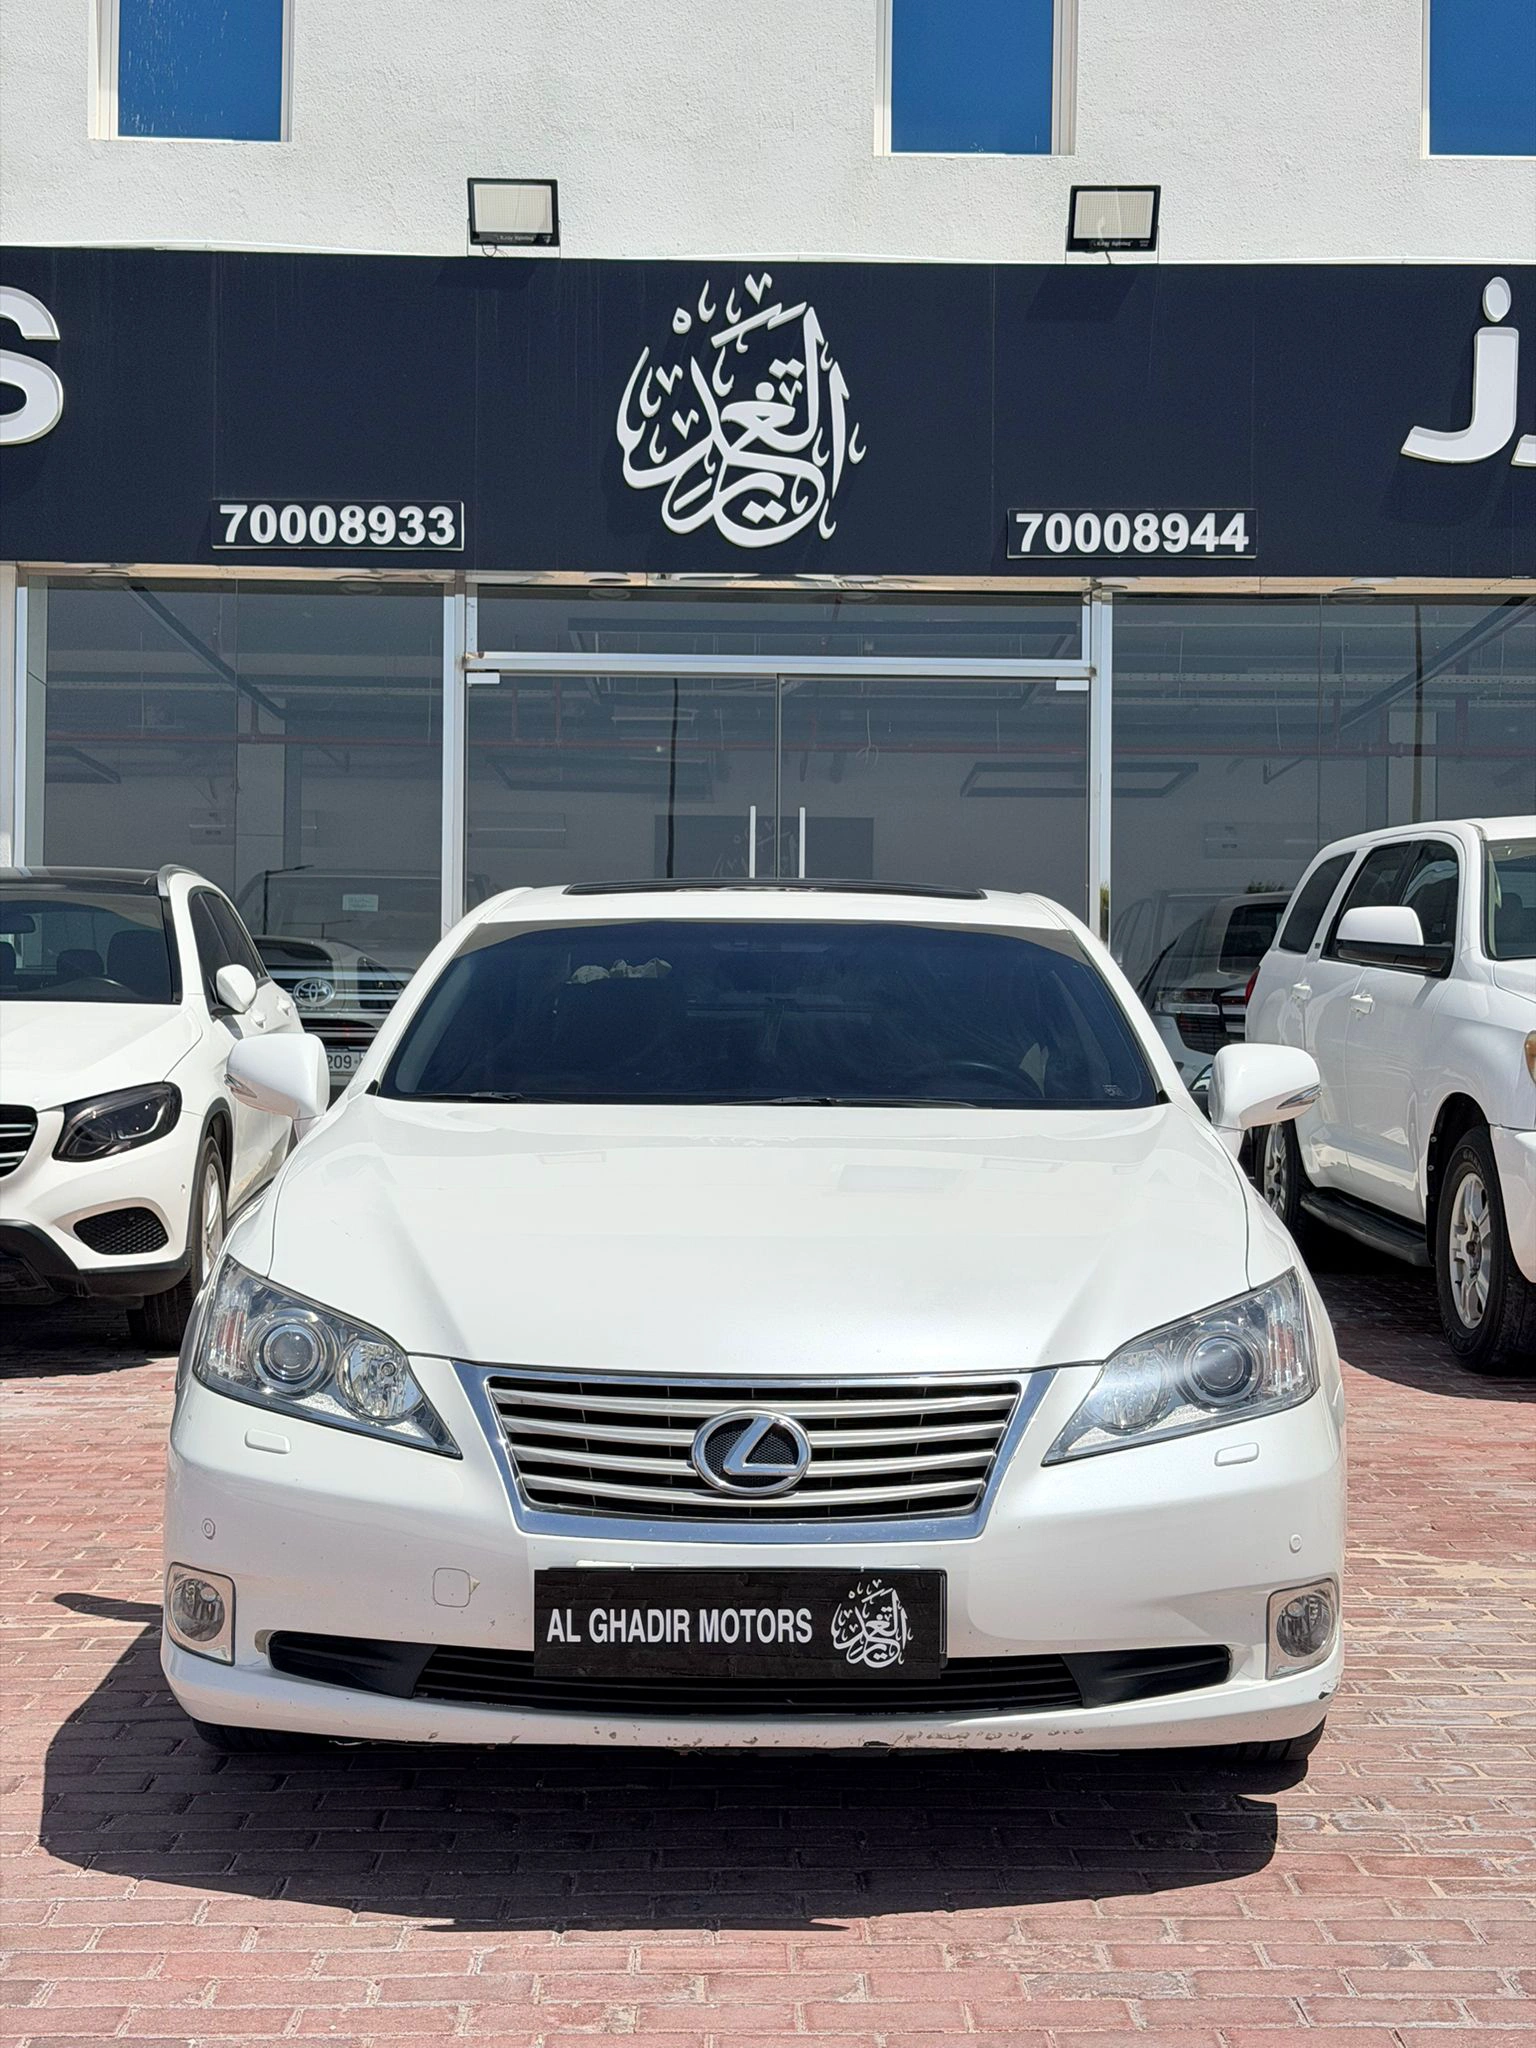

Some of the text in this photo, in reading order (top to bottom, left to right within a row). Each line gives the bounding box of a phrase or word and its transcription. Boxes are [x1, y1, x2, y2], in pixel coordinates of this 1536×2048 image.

[219, 504, 456, 545] 70008933
[1015, 512, 1249, 553] 70008944
[546, 1607, 813, 1644] AL GHADIR MOTORS
